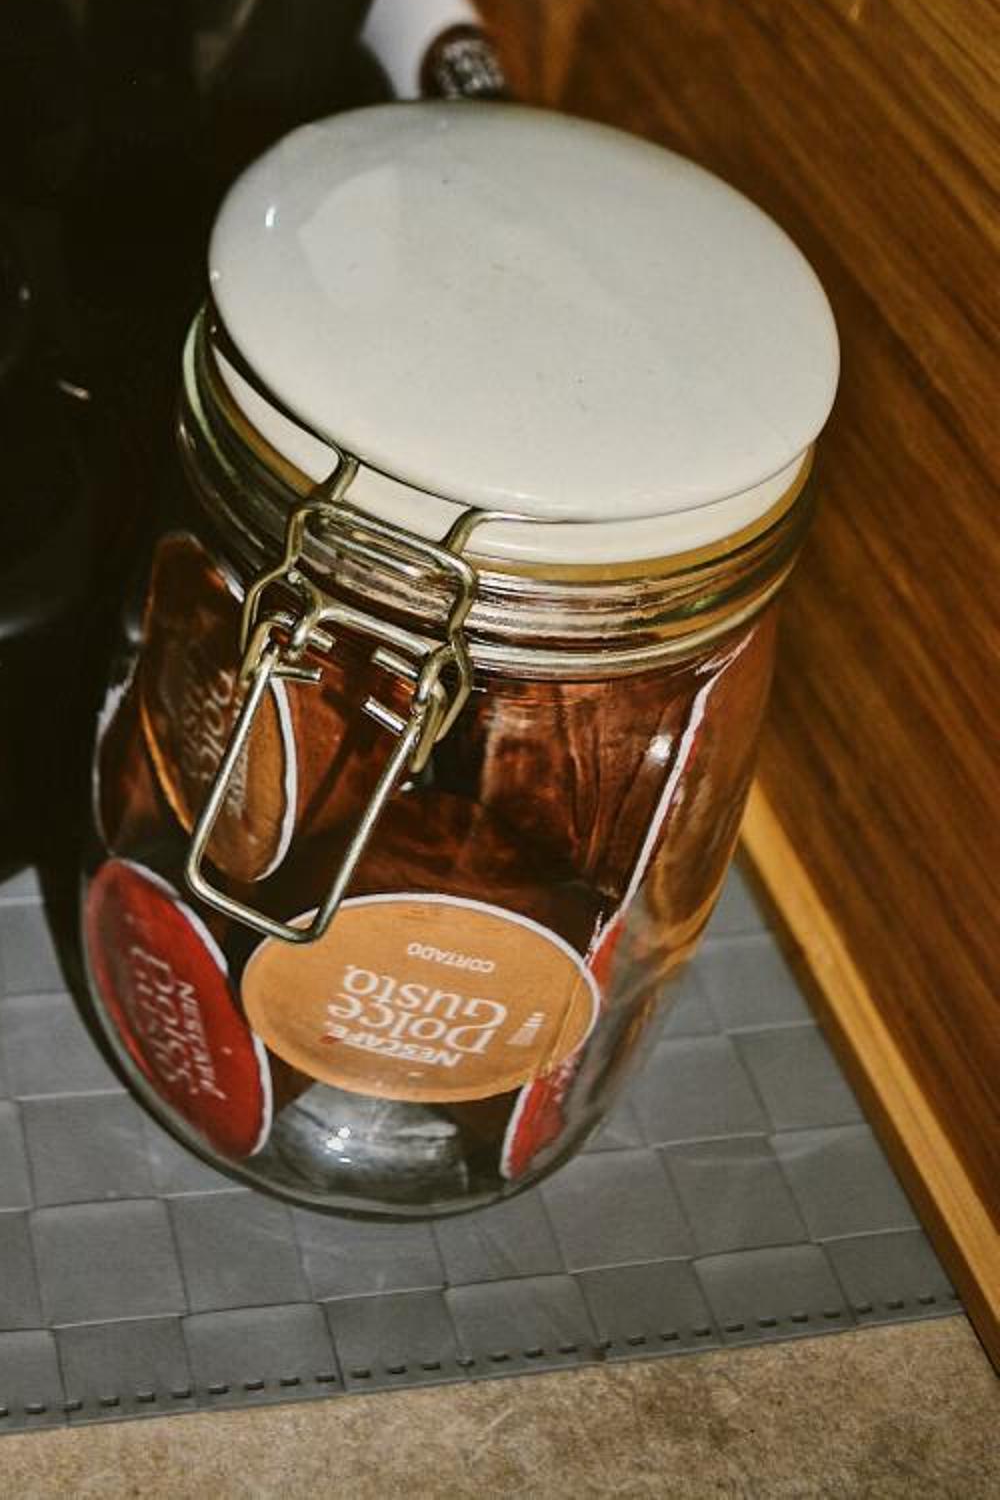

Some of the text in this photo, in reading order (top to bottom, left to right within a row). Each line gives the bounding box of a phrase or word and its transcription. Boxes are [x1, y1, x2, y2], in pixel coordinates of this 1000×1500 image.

[407, 942, 496, 974] CORTADO
[322, 1020, 463, 1067] NESCAFÉ
[327, 993, 497, 1054] Dolce
